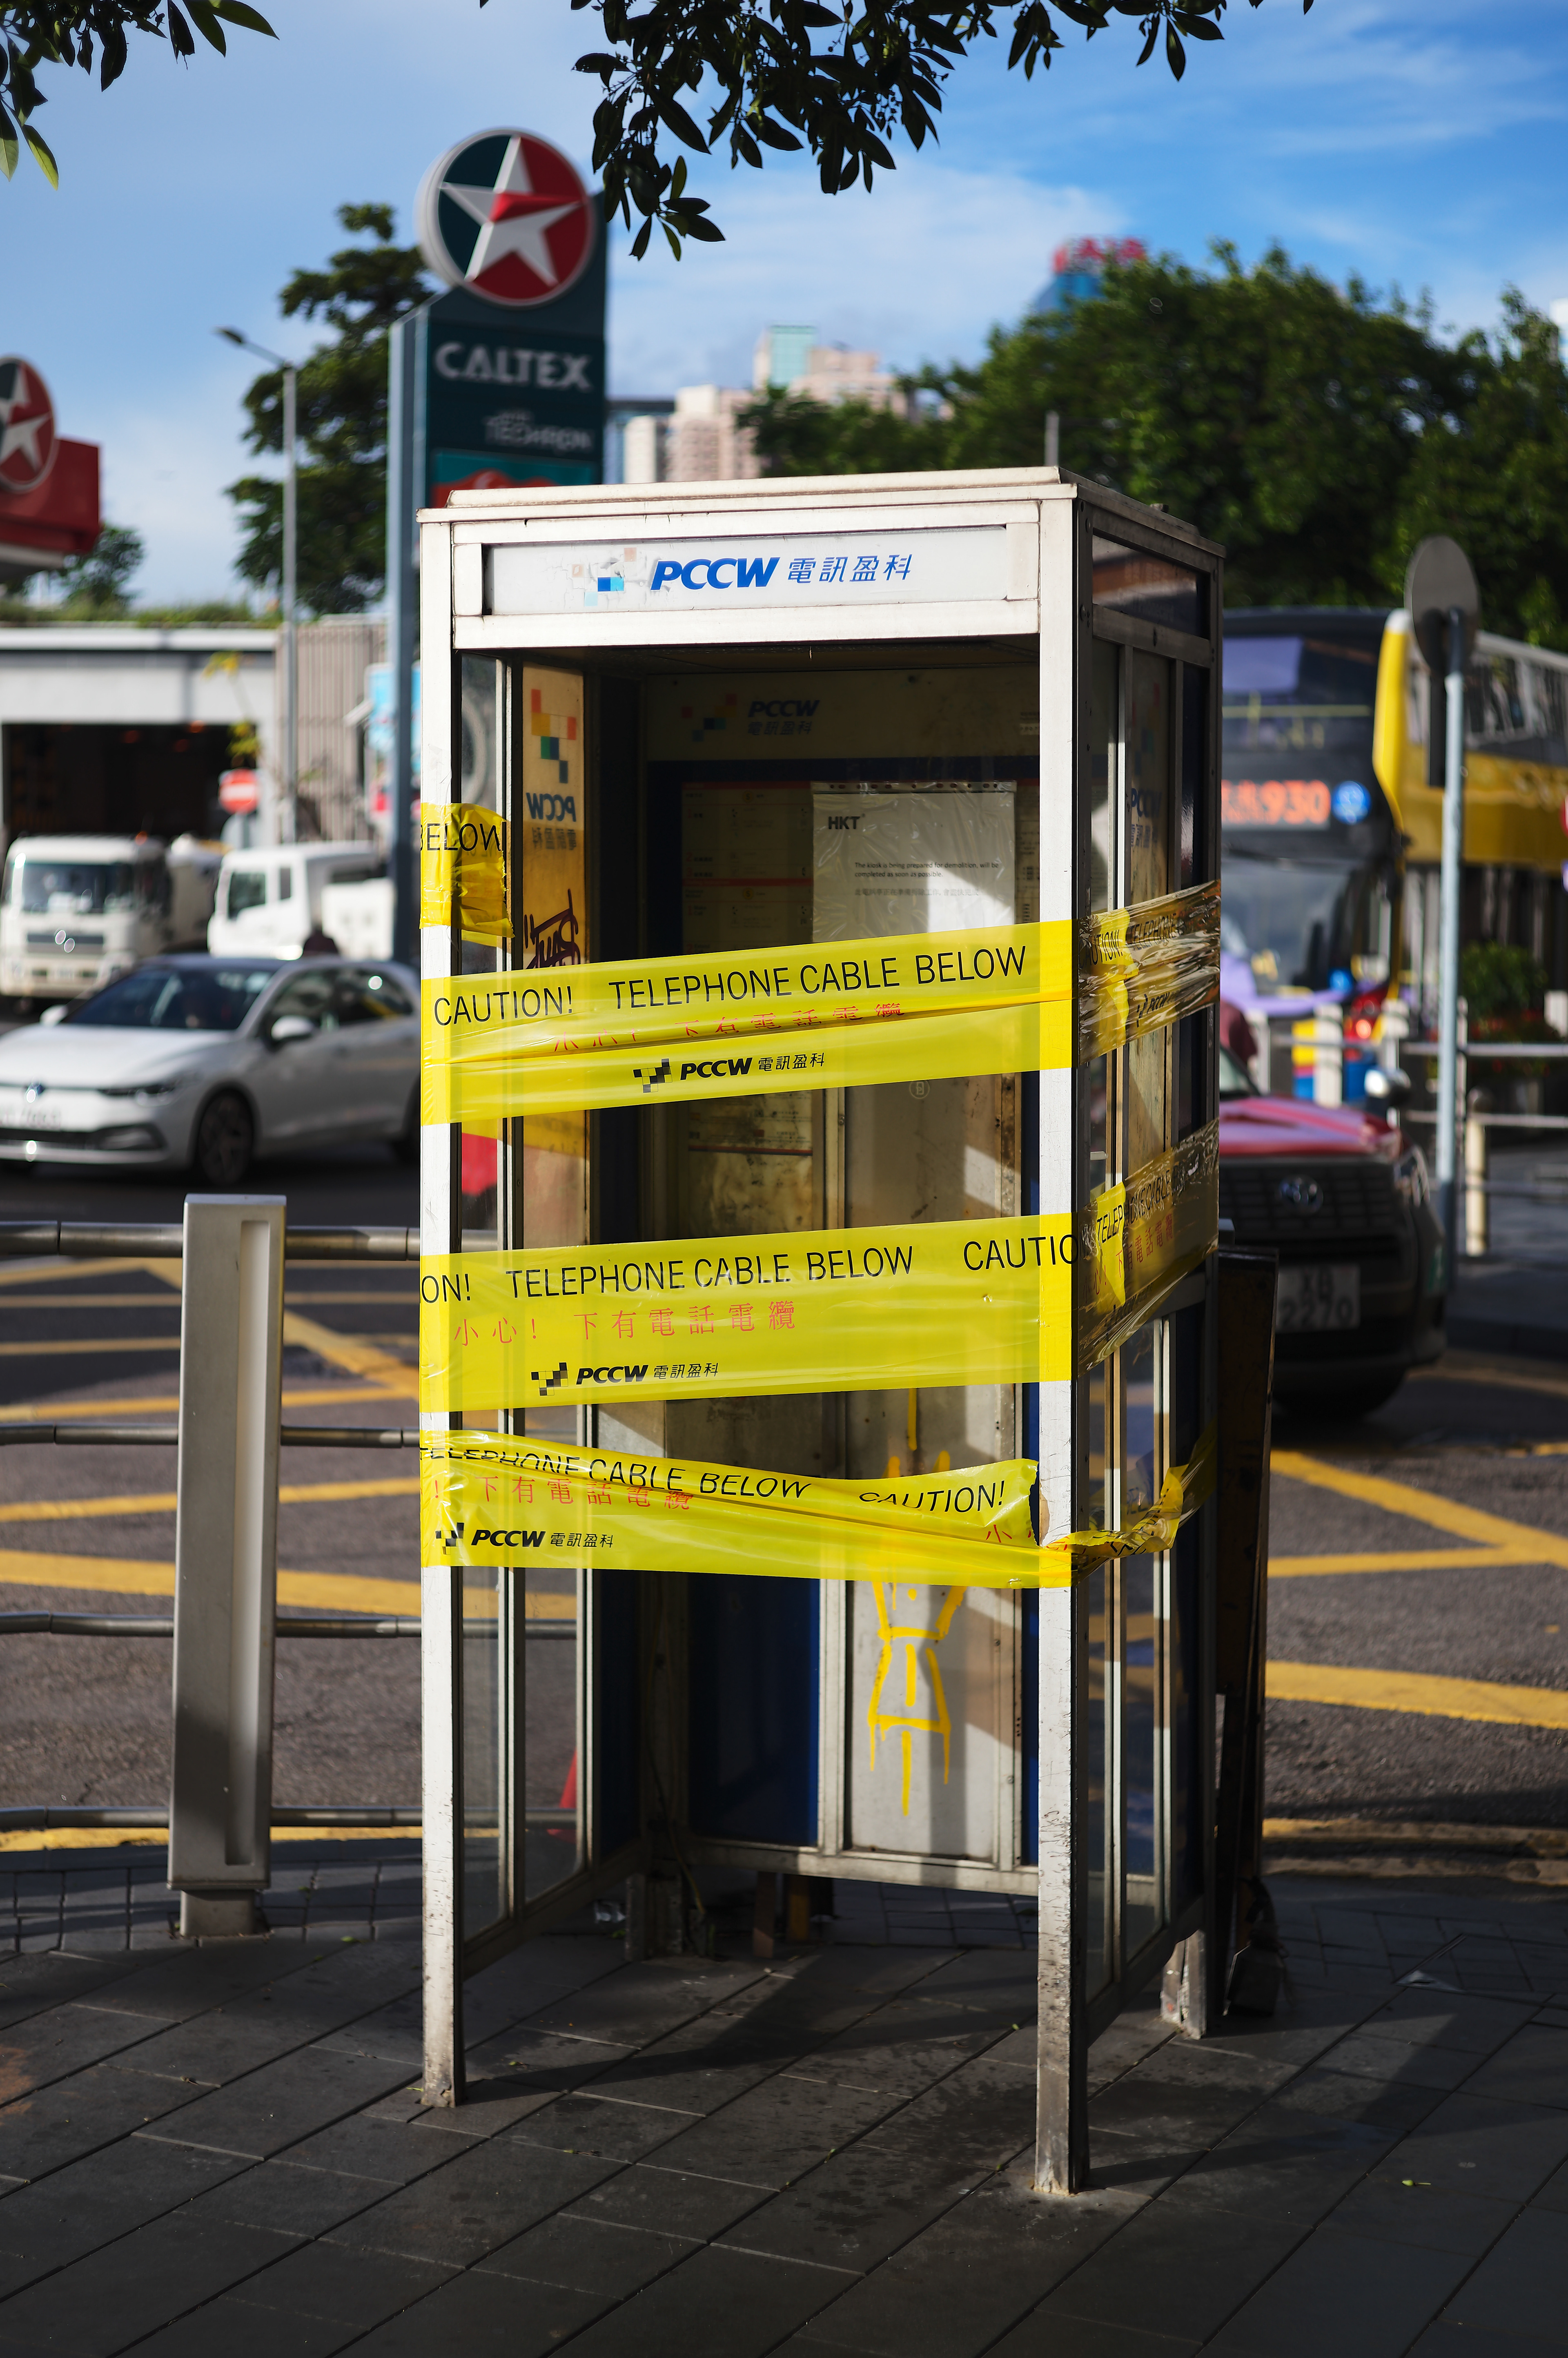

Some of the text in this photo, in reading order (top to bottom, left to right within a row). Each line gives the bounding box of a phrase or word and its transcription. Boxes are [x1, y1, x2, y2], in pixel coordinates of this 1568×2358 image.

[434, 342, 592, 390] CALTEX
[651, 554, 913, 591] PCCW 電訊盈科
[747, 700, 820, 718] PCCW
[421, 823, 501, 851] ELOW
[828, 816, 860, 830] HKT
[434, 946, 1026, 1025] CAUTION! TELEPHONE CABLE BELOW
[680, 1052, 825, 1080] PCCW 電訊盈科
[506, 1260, 685, 1298] TELEPHONE
[695, 1254, 791, 1288] CABLE
[806, 1246, 913, 1281] BELOW
[574, 1300, 795, 1340] 下有電話電纜
[576, 1362, 718, 1385] PCCW 電訊盈科
[475, 1476, 694, 1510] 下有電話電纜
[589, 1459, 686, 1491] CABLE
[700, 1473, 812, 1498] BELOW
[859, 1480, 1005, 1513] CAUTION!
[471, 1529, 613, 1548] PCCW 電訊盈科
